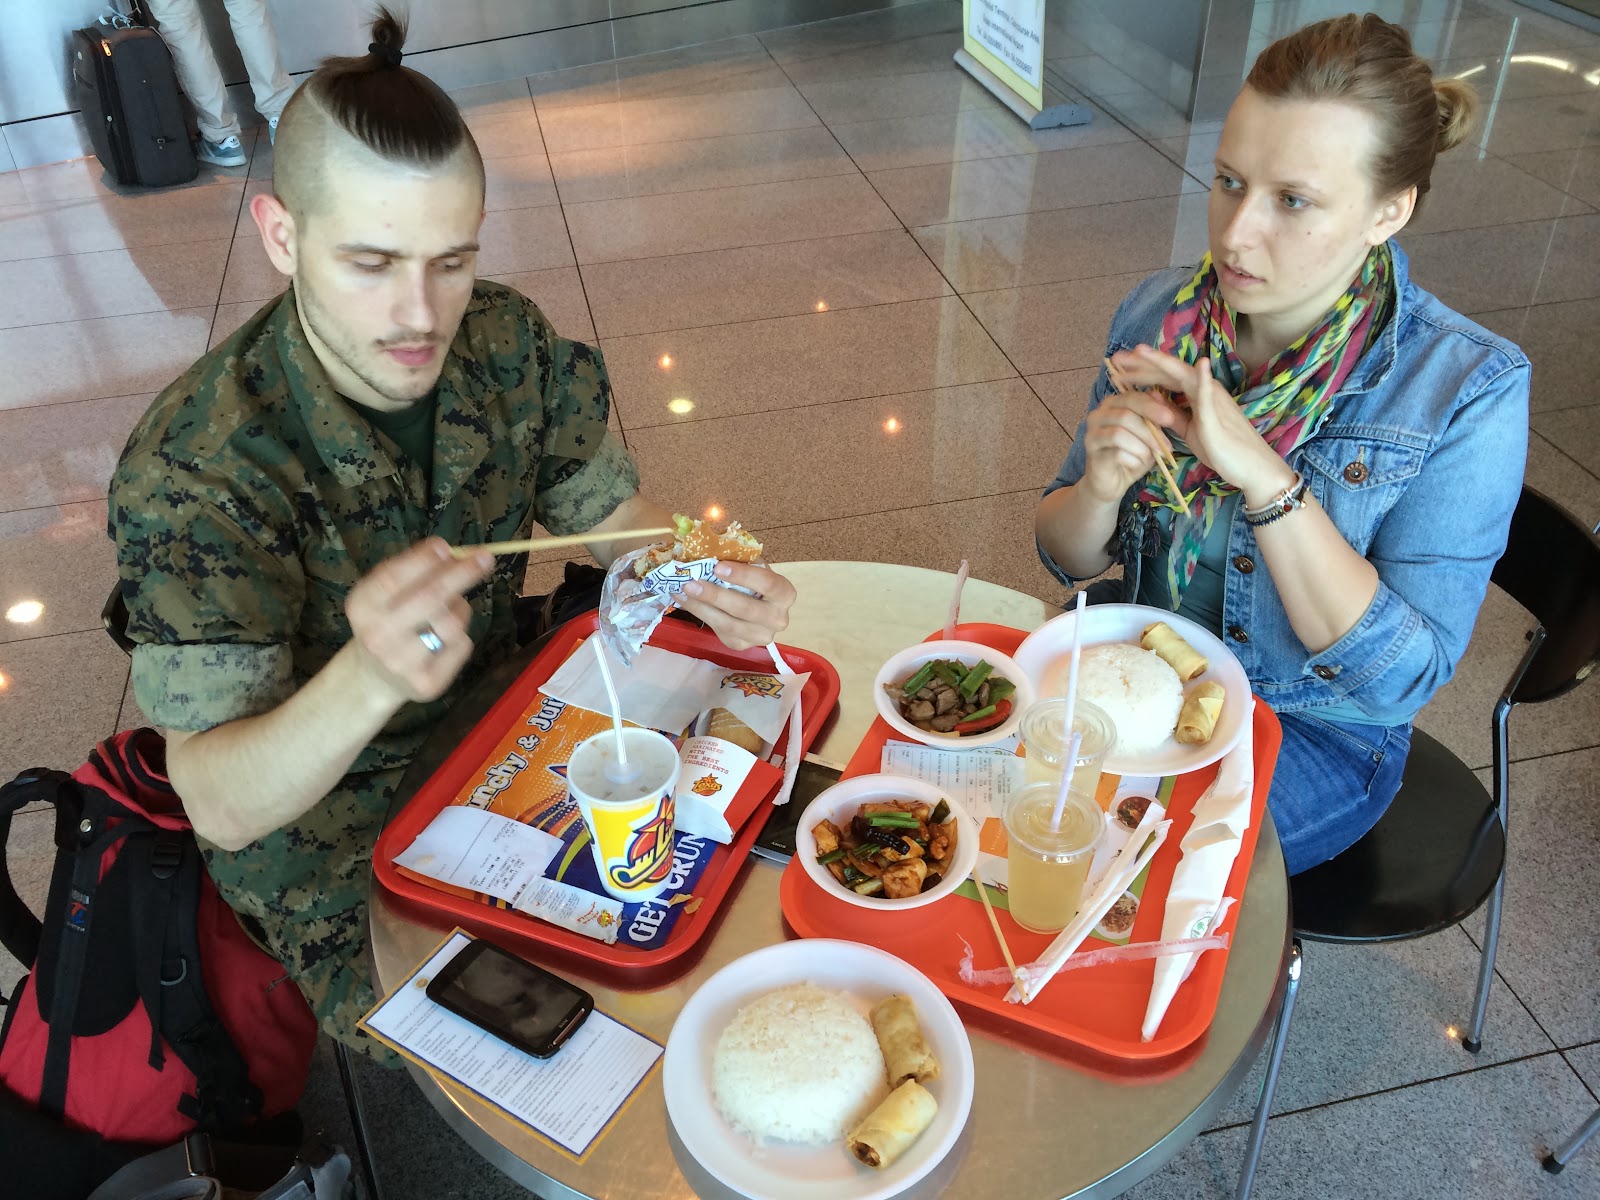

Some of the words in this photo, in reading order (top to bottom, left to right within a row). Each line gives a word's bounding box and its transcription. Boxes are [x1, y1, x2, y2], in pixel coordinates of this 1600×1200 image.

[517, 734, 540, 751] &
[702, 756, 719, 764] BEST
[684, 760, 729, 774] INGREDIENTS
[771, 841, 786, 849] SONY
